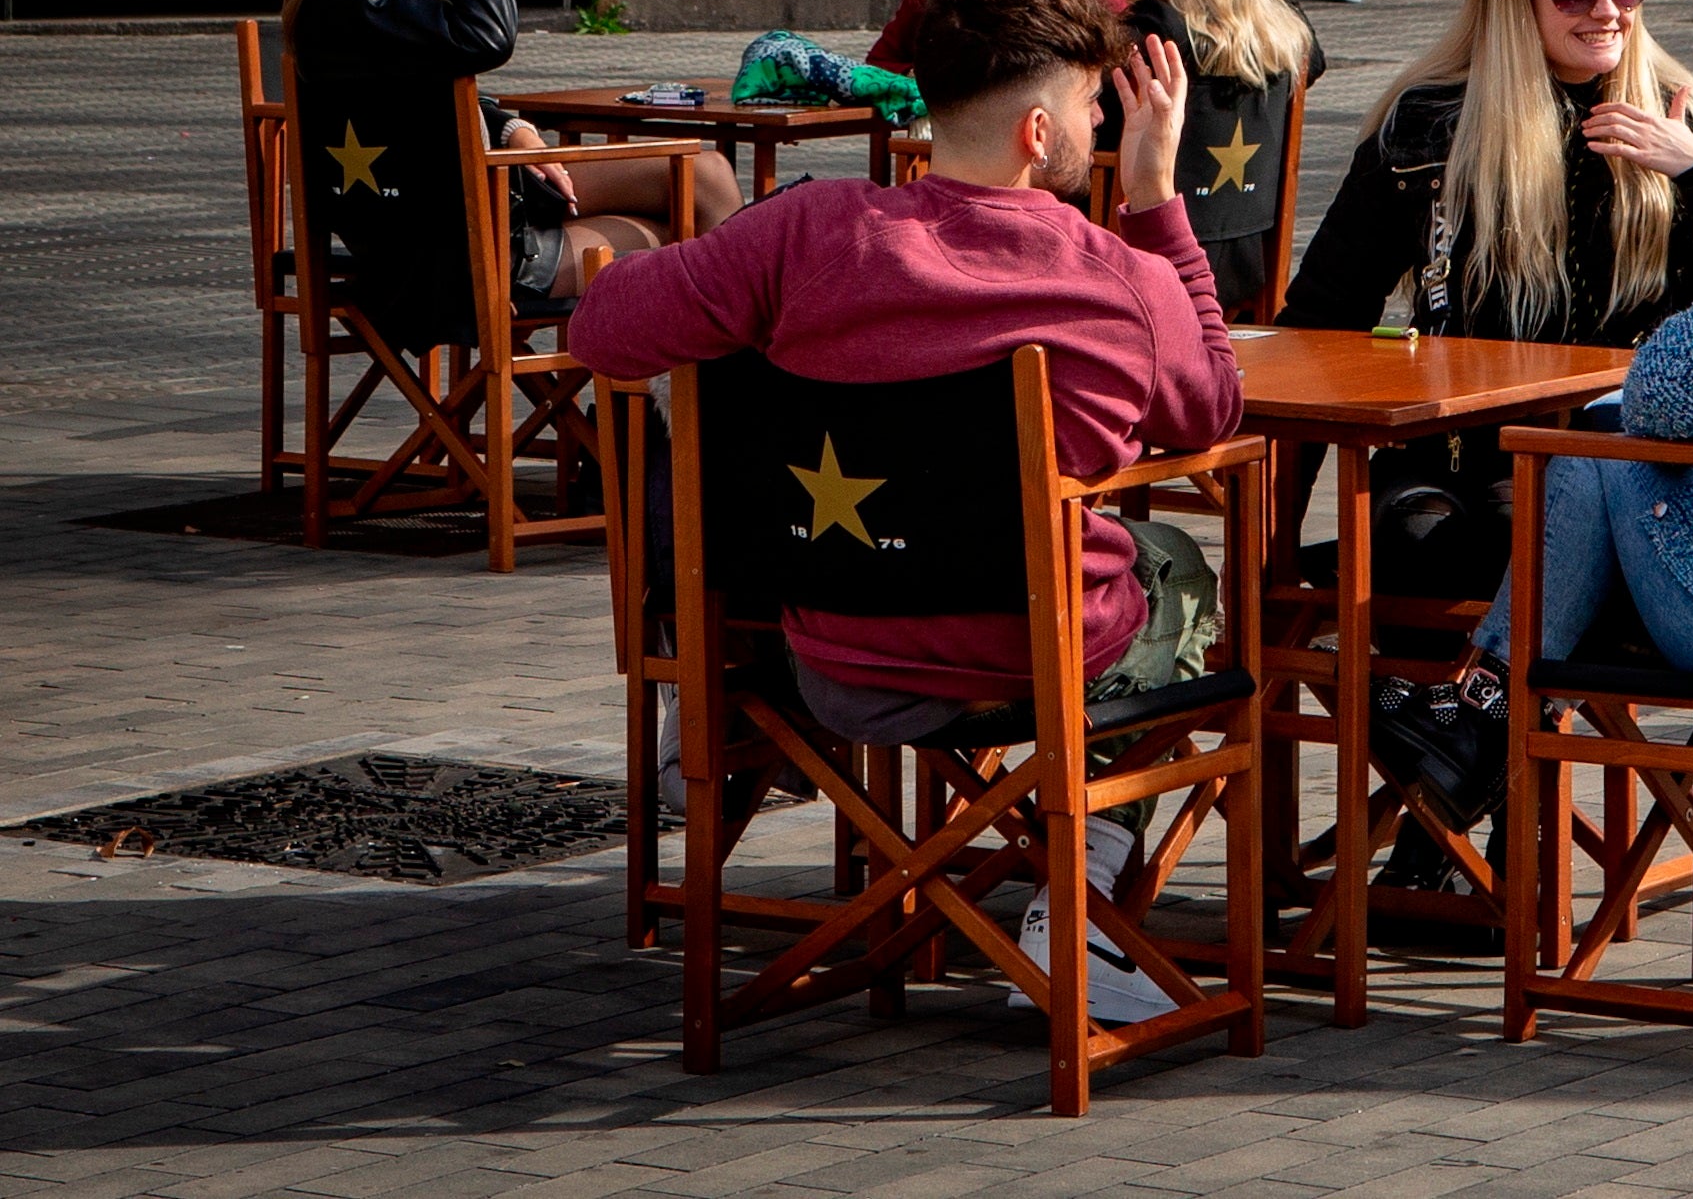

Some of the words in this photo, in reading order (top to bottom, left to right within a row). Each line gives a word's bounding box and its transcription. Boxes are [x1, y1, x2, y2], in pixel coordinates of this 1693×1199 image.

[382, 187, 400, 197] 76
[789, 524, 808, 539] 18
[877, 538, 906, 550] 76
